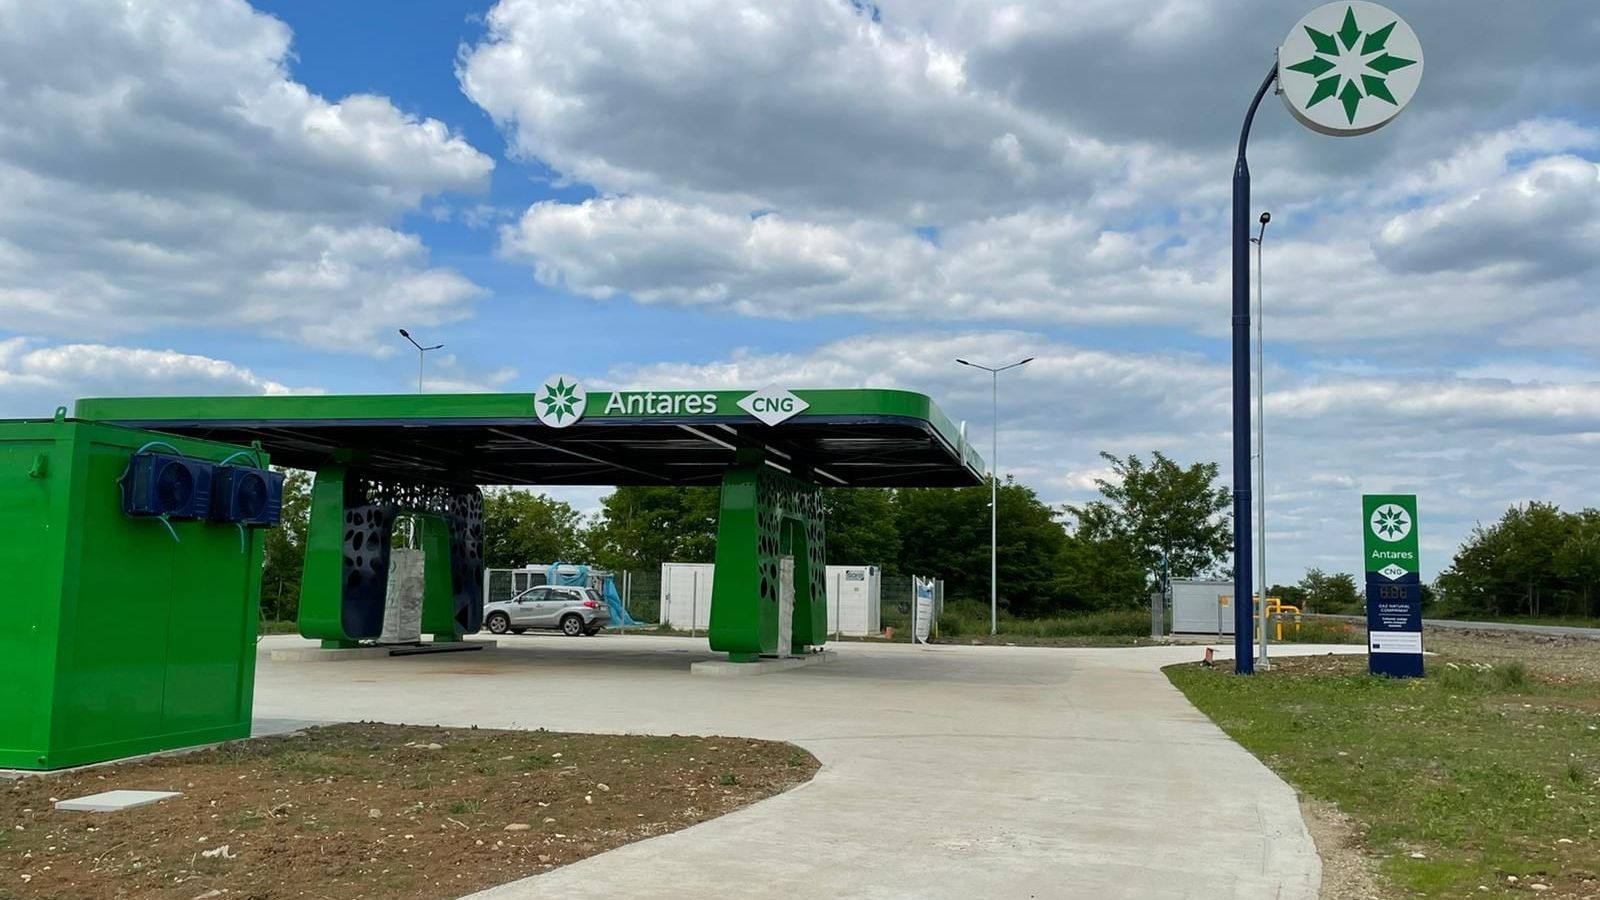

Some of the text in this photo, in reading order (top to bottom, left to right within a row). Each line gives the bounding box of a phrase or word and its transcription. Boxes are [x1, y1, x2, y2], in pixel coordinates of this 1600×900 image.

[604, 391, 717, 415] Antares
[752, 397, 794, 413] CNG
[1371, 549, 1414, 559] Antares
[1384, 568, 1402, 576] CNG
